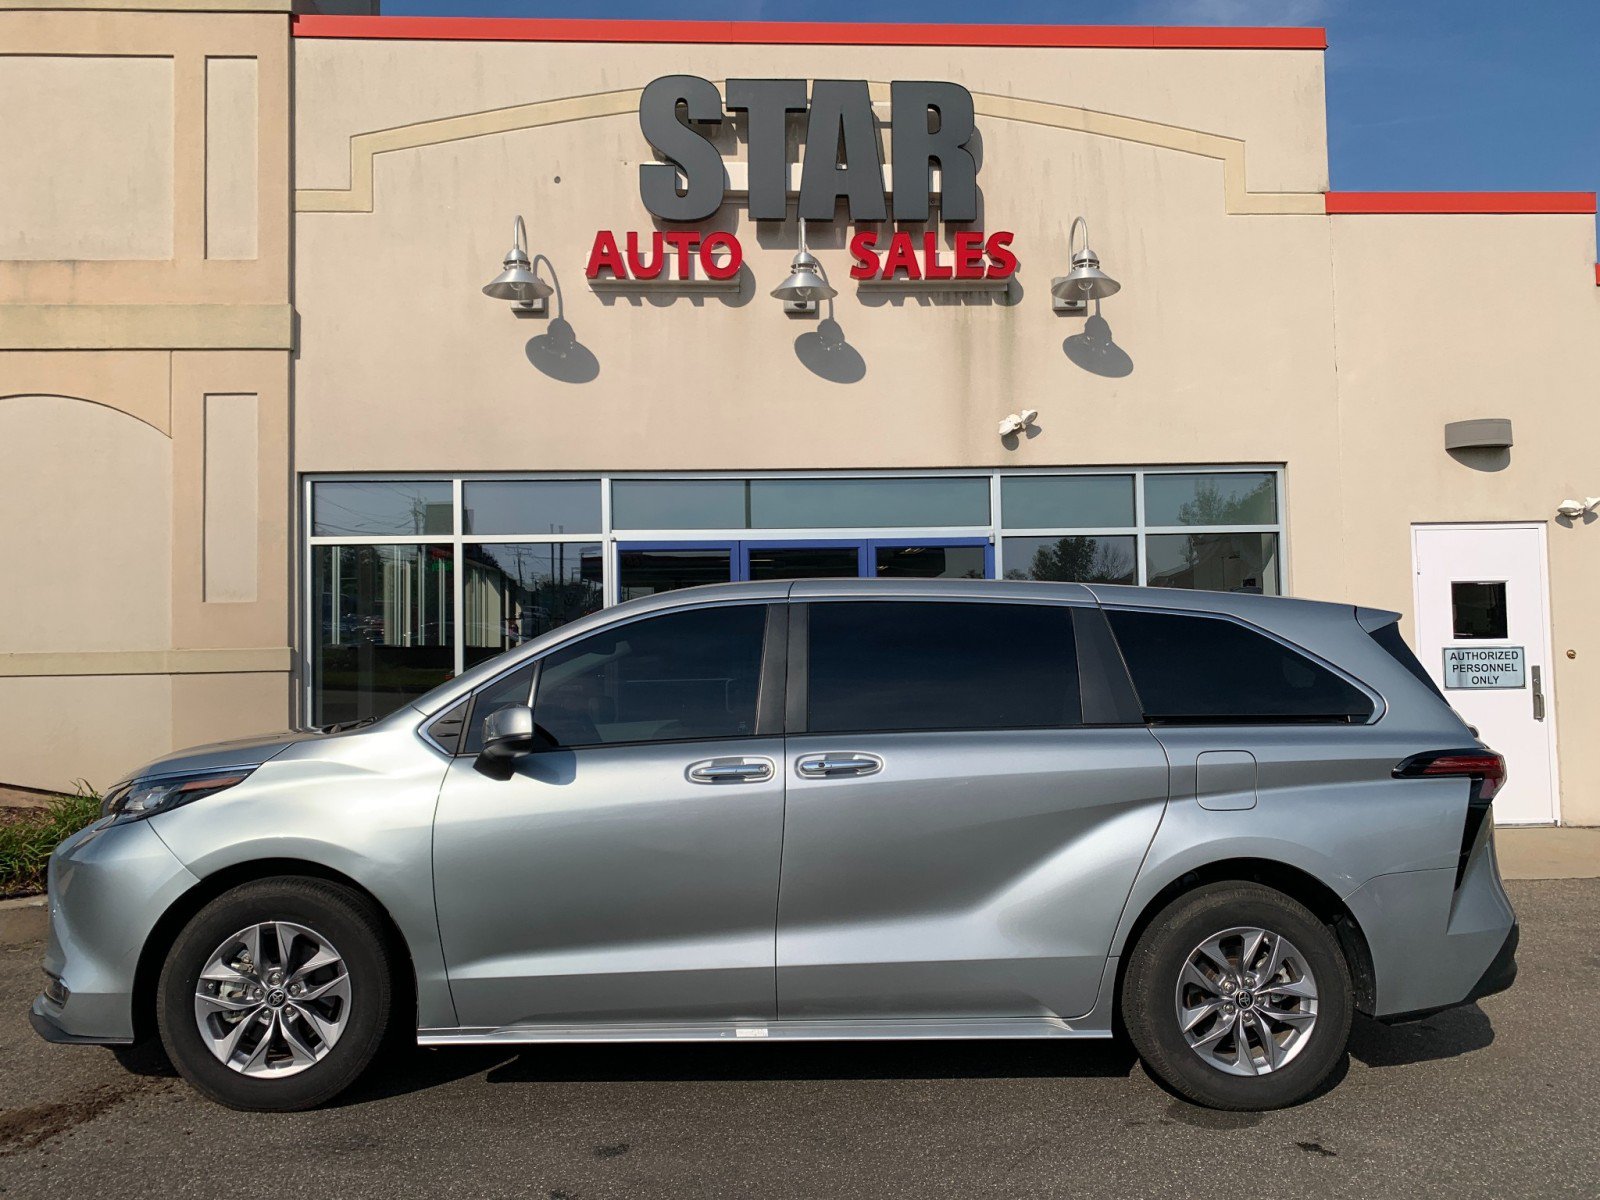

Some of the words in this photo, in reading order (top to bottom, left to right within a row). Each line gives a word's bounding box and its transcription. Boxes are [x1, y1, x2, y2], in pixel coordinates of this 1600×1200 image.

[639, 75, 977, 222] STAR
[586, 230, 743, 280] AUTO
[850, 231, 1018, 280] SALES
[1450, 651, 1519, 661] AUTHORIZED
[1452, 663, 1518, 673] PERSONNEL
[1471, 675, 1500, 685] ONLY
